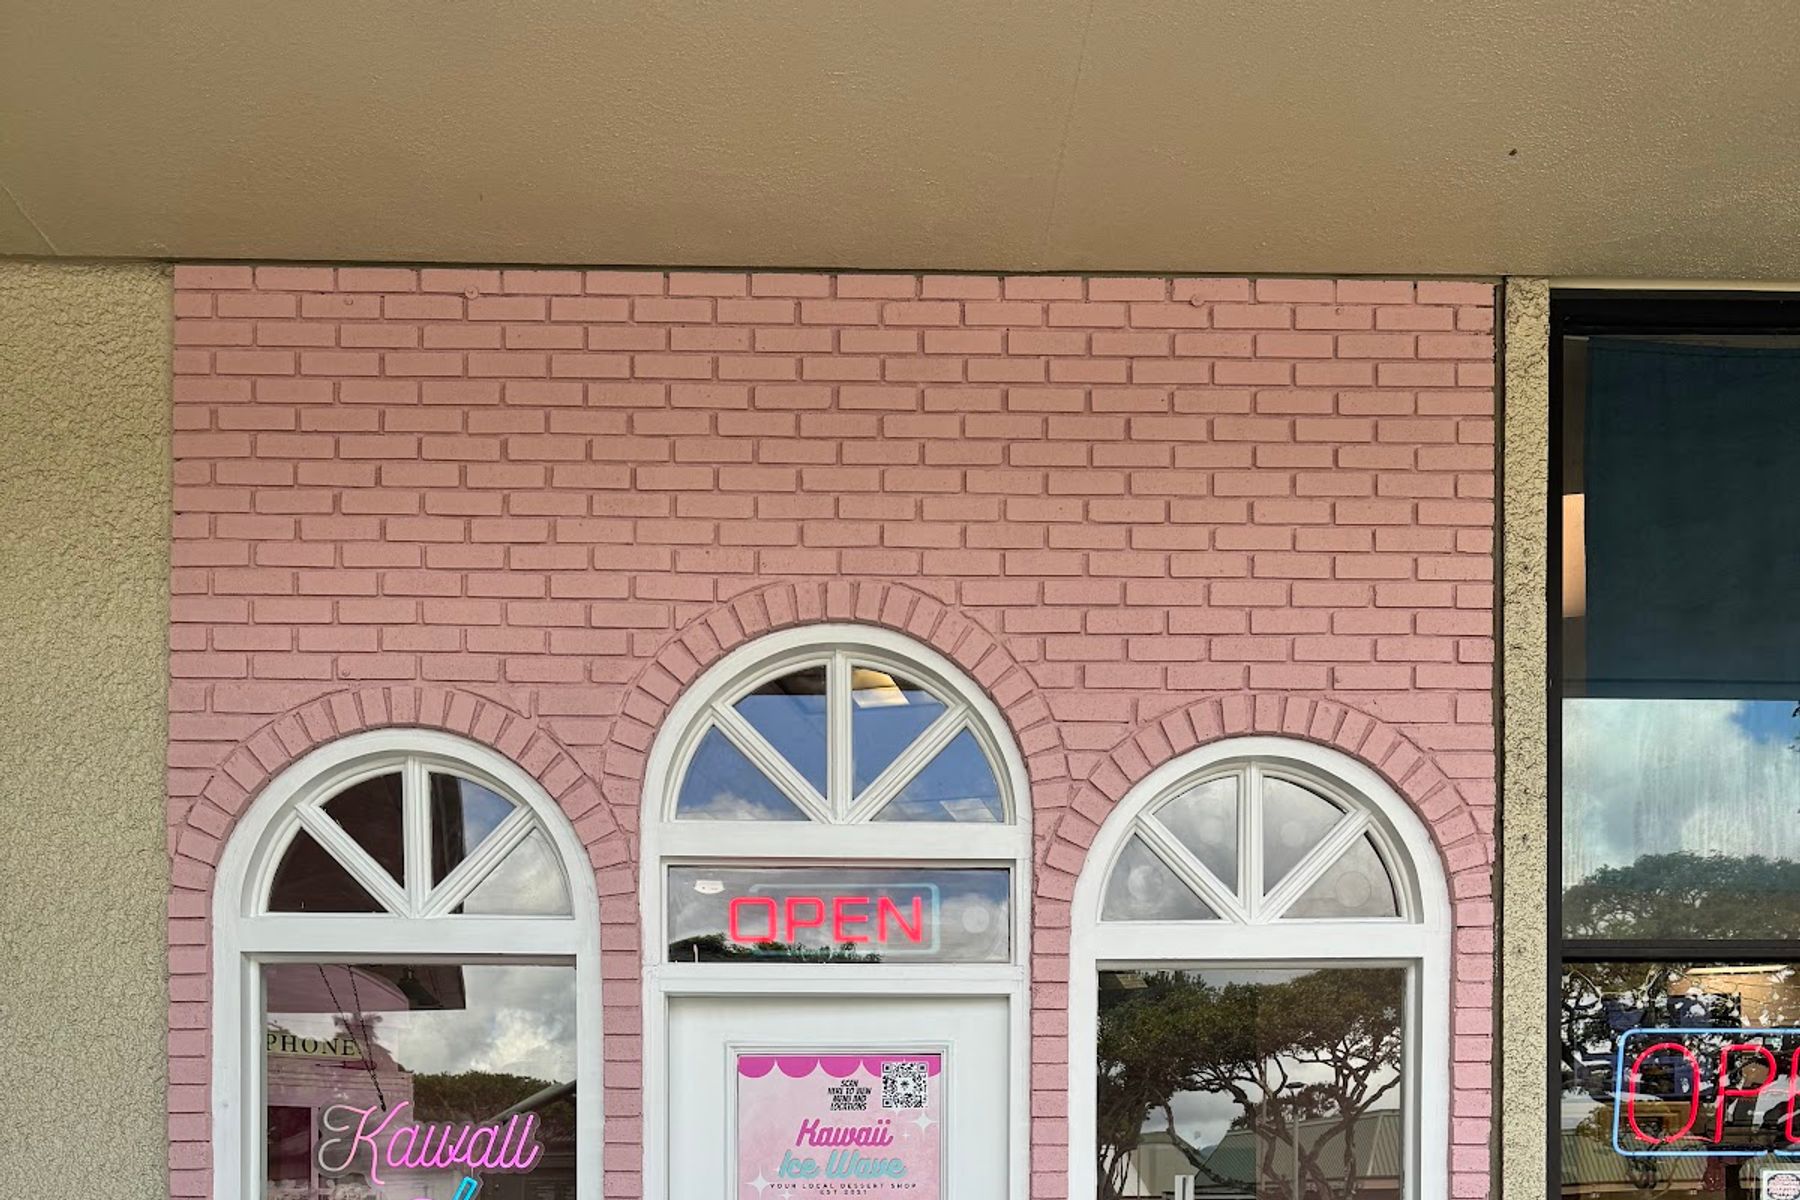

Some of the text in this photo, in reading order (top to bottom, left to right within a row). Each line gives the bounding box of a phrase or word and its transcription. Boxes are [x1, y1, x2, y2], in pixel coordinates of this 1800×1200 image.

[728, 895, 922, 944] OPEN
[795, 1118, 894, 1147] Kawaii
[778, 1149, 909, 1180] Ice Wave
